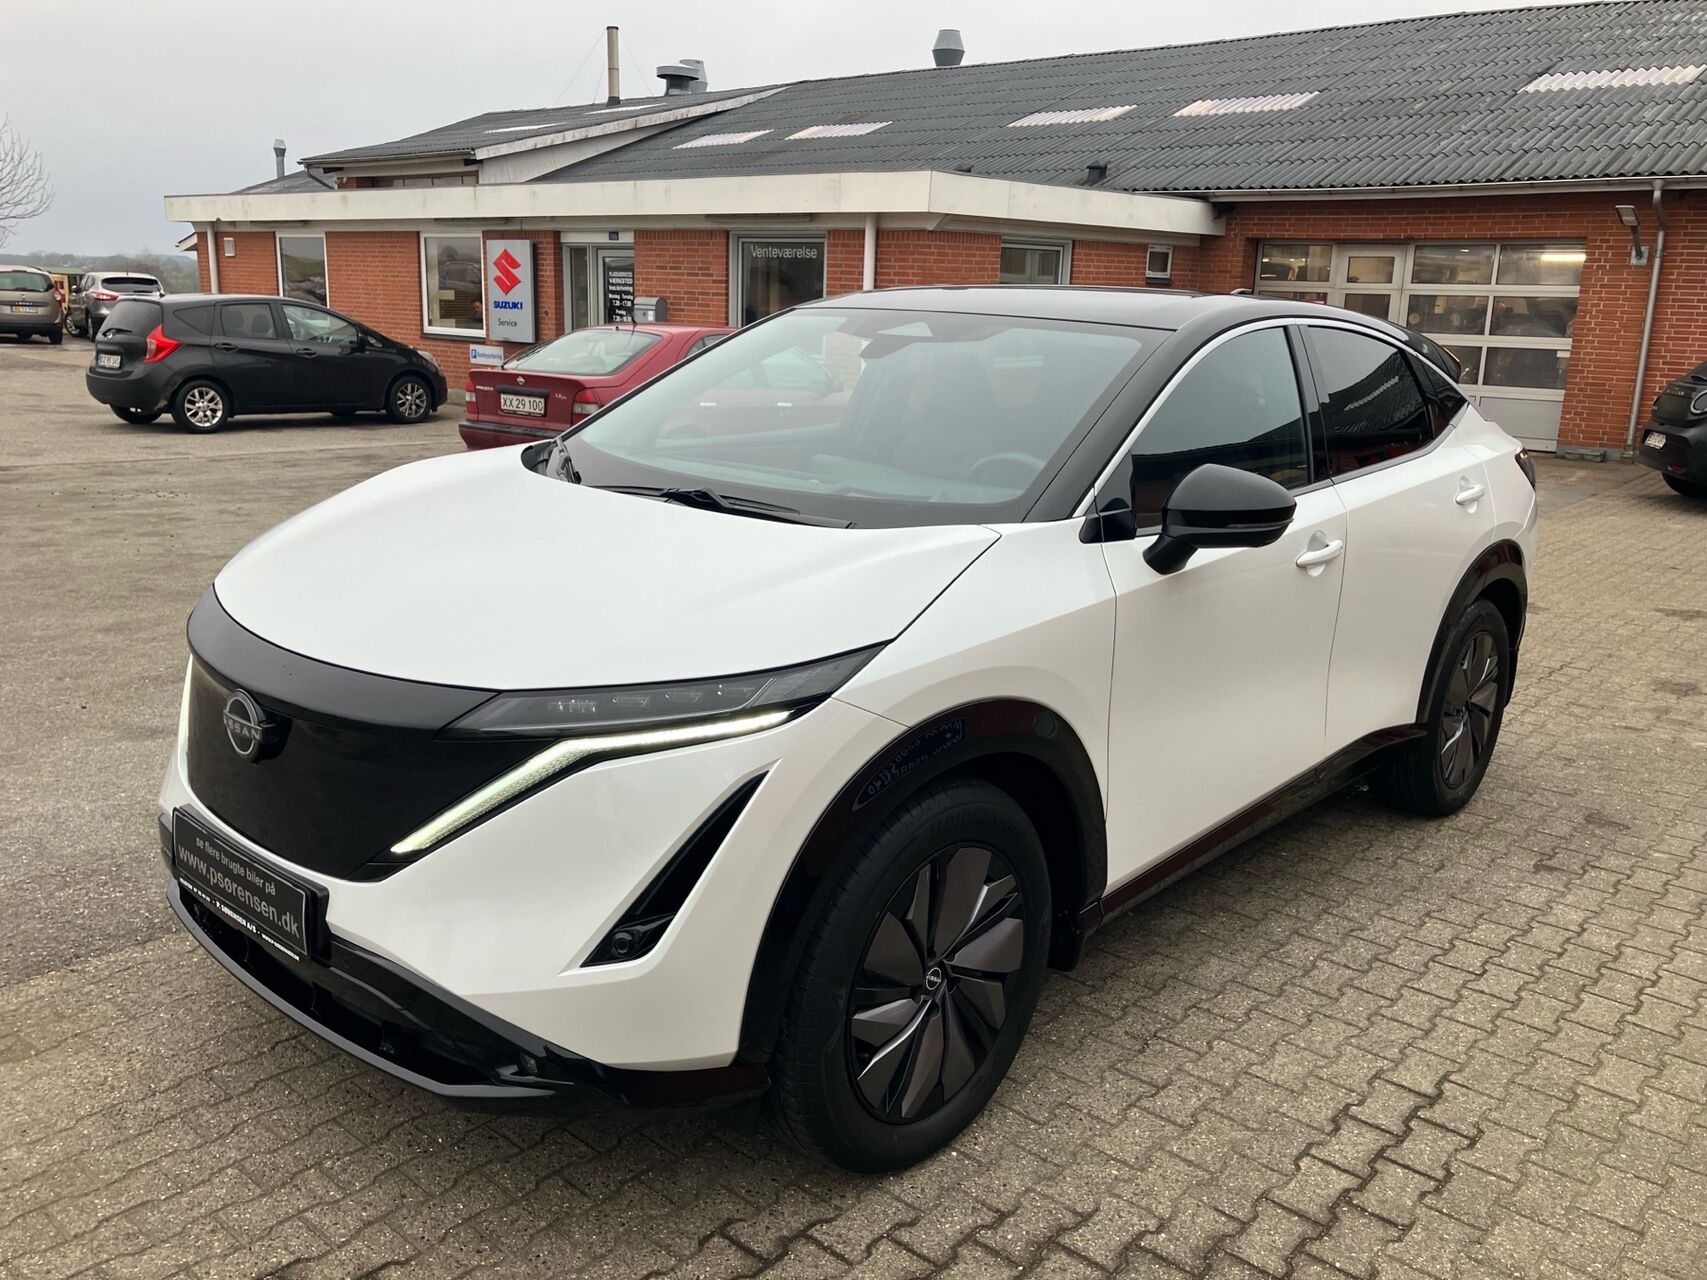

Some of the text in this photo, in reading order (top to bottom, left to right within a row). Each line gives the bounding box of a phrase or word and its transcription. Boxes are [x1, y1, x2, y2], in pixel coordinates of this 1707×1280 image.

[750, 244, 818, 259] Venteværelse
[493, 300, 523, 311] SUZUKI
[498, 318, 518, 327] Service
[502, 396, 514, 409] XX
[515, 398, 526, 410] 29
[196, 837, 276, 896] se flere brugte biler på
[178, 845, 300, 938] www.psørensen.dk
